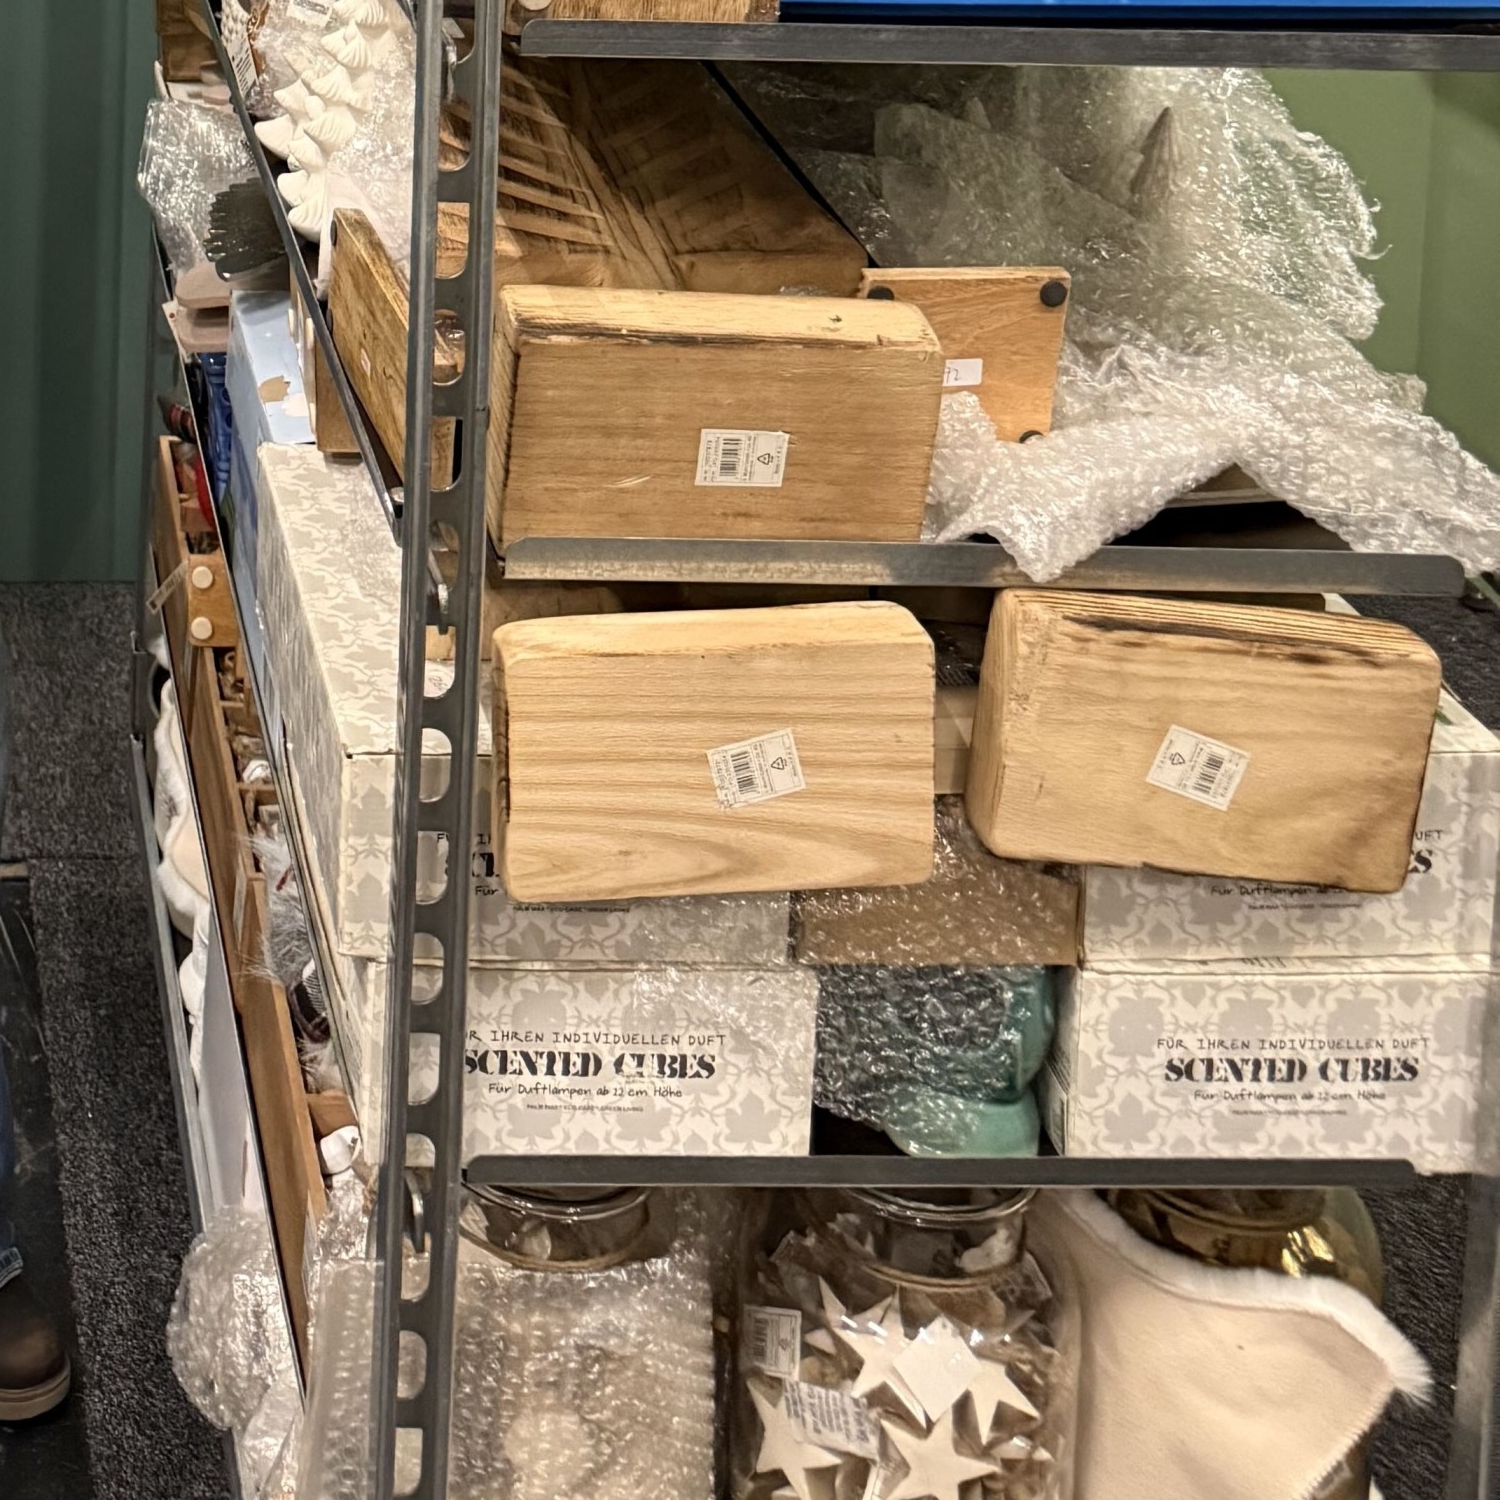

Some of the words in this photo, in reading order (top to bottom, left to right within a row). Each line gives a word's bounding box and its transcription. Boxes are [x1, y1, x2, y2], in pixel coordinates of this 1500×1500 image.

[1415, 830, 1443, 841] UFT
[475, 884, 499, 896] Für
[490, 1030, 544, 1042] IHREN
[553, 1032, 680, 1045] INDIVIDUELLEN
[688, 1034, 726, 1045] DUFT
[1157, 1036, 1188, 1049] FÜR
[1197, 1038, 1250, 1050] IHREN
[1259, 1038, 1385, 1049] INDIVIDUELLEN
[1393, 1037, 1430, 1049] DUFT
[464, 1049, 603, 1077] SCENTED
[613, 1052, 716, 1079] CUBES
[1164, 1057, 1307, 1083] SCENTED
[1318, 1057, 1419, 1083] CUBES
[488, 1083, 511, 1094] Für
[518, 1081, 592, 1099] Duftlampen
[596, 1085, 610, 1096] ab
[627, 1088, 648, 1097] cm
[653, 1086, 683, 1098] Höhe
